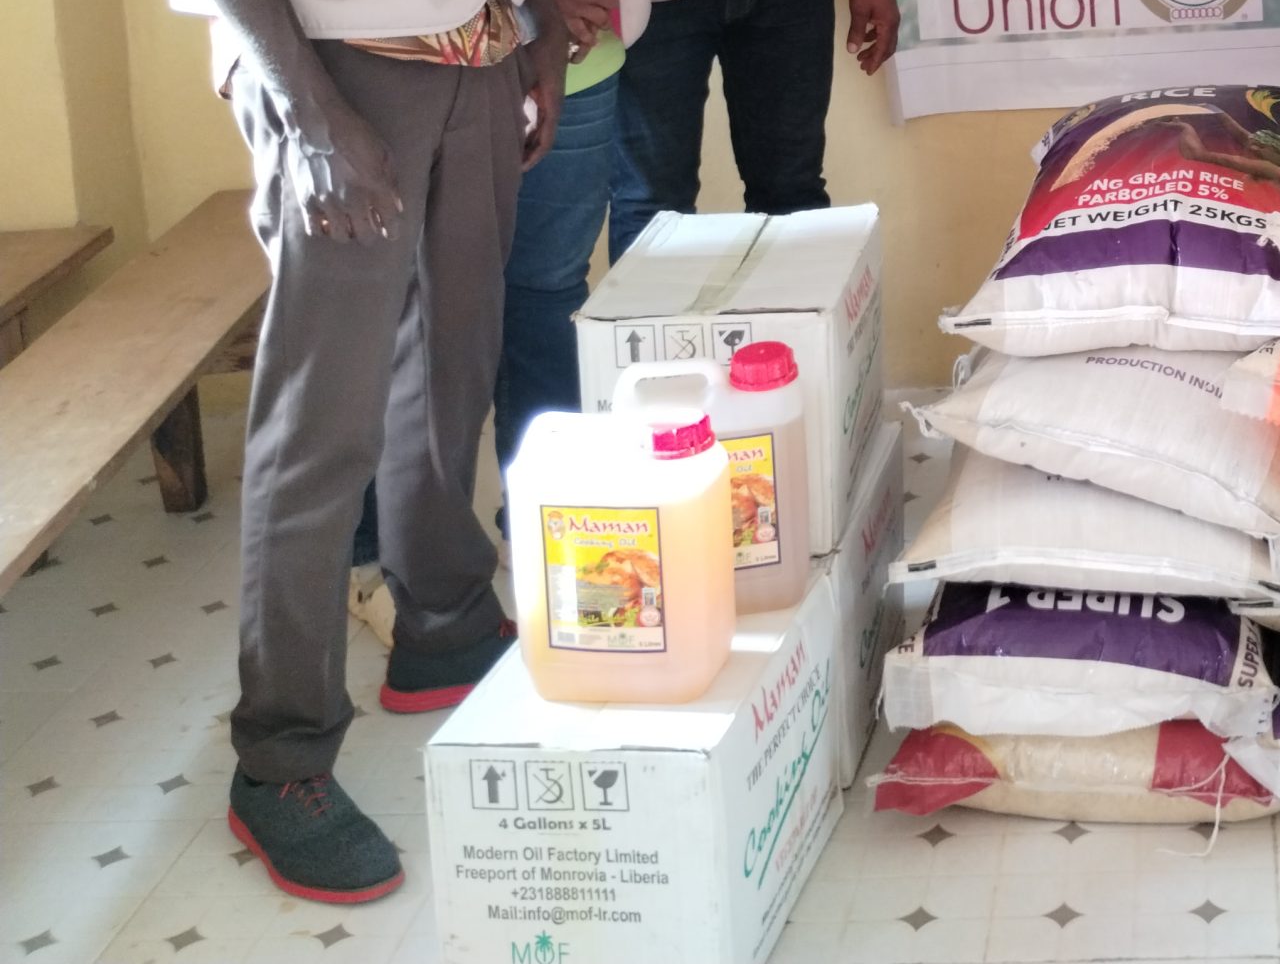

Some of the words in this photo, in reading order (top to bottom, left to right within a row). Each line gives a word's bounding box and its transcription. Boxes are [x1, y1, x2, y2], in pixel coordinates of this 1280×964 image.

[1121, 87, 1217, 103] RICE
[1129, 169, 1193, 185] GRAIN
[1199, 171, 1245, 191] RICE
[1078, 181, 1192, 206] PARBOILED
[1197, 184, 1229, 200] 5%
[1088, 199, 1183, 224] WEIGHT
[1188, 204, 1267, 229] 25KGS
[1086, 355, 1187, 382] PRODUCTION
[1189, 374, 1224, 400] INDI
[569, 516, 649, 533] Maman
[985, 587, 1011, 614] 1
[1026, 588, 1186, 624] SUPER
[498, 818, 508, 829] 4
[513, 817, 574, 831] Gallons
[579, 821, 588, 830] x
[592, 818, 612, 831] 5L
[463, 845, 518, 861] Modern
[523, 846, 543, 861] Oil
[547, 847, 601, 865] Factory
[605, 848, 659, 865] Limited
[456, 865, 517, 883] Freeport
[521, 867, 536, 880] of
[540, 867, 607, 882] Monrovia
[620, 869, 669, 885] Liberia
[488, 904, 642, 925] Mail:info@mof-lr.com
